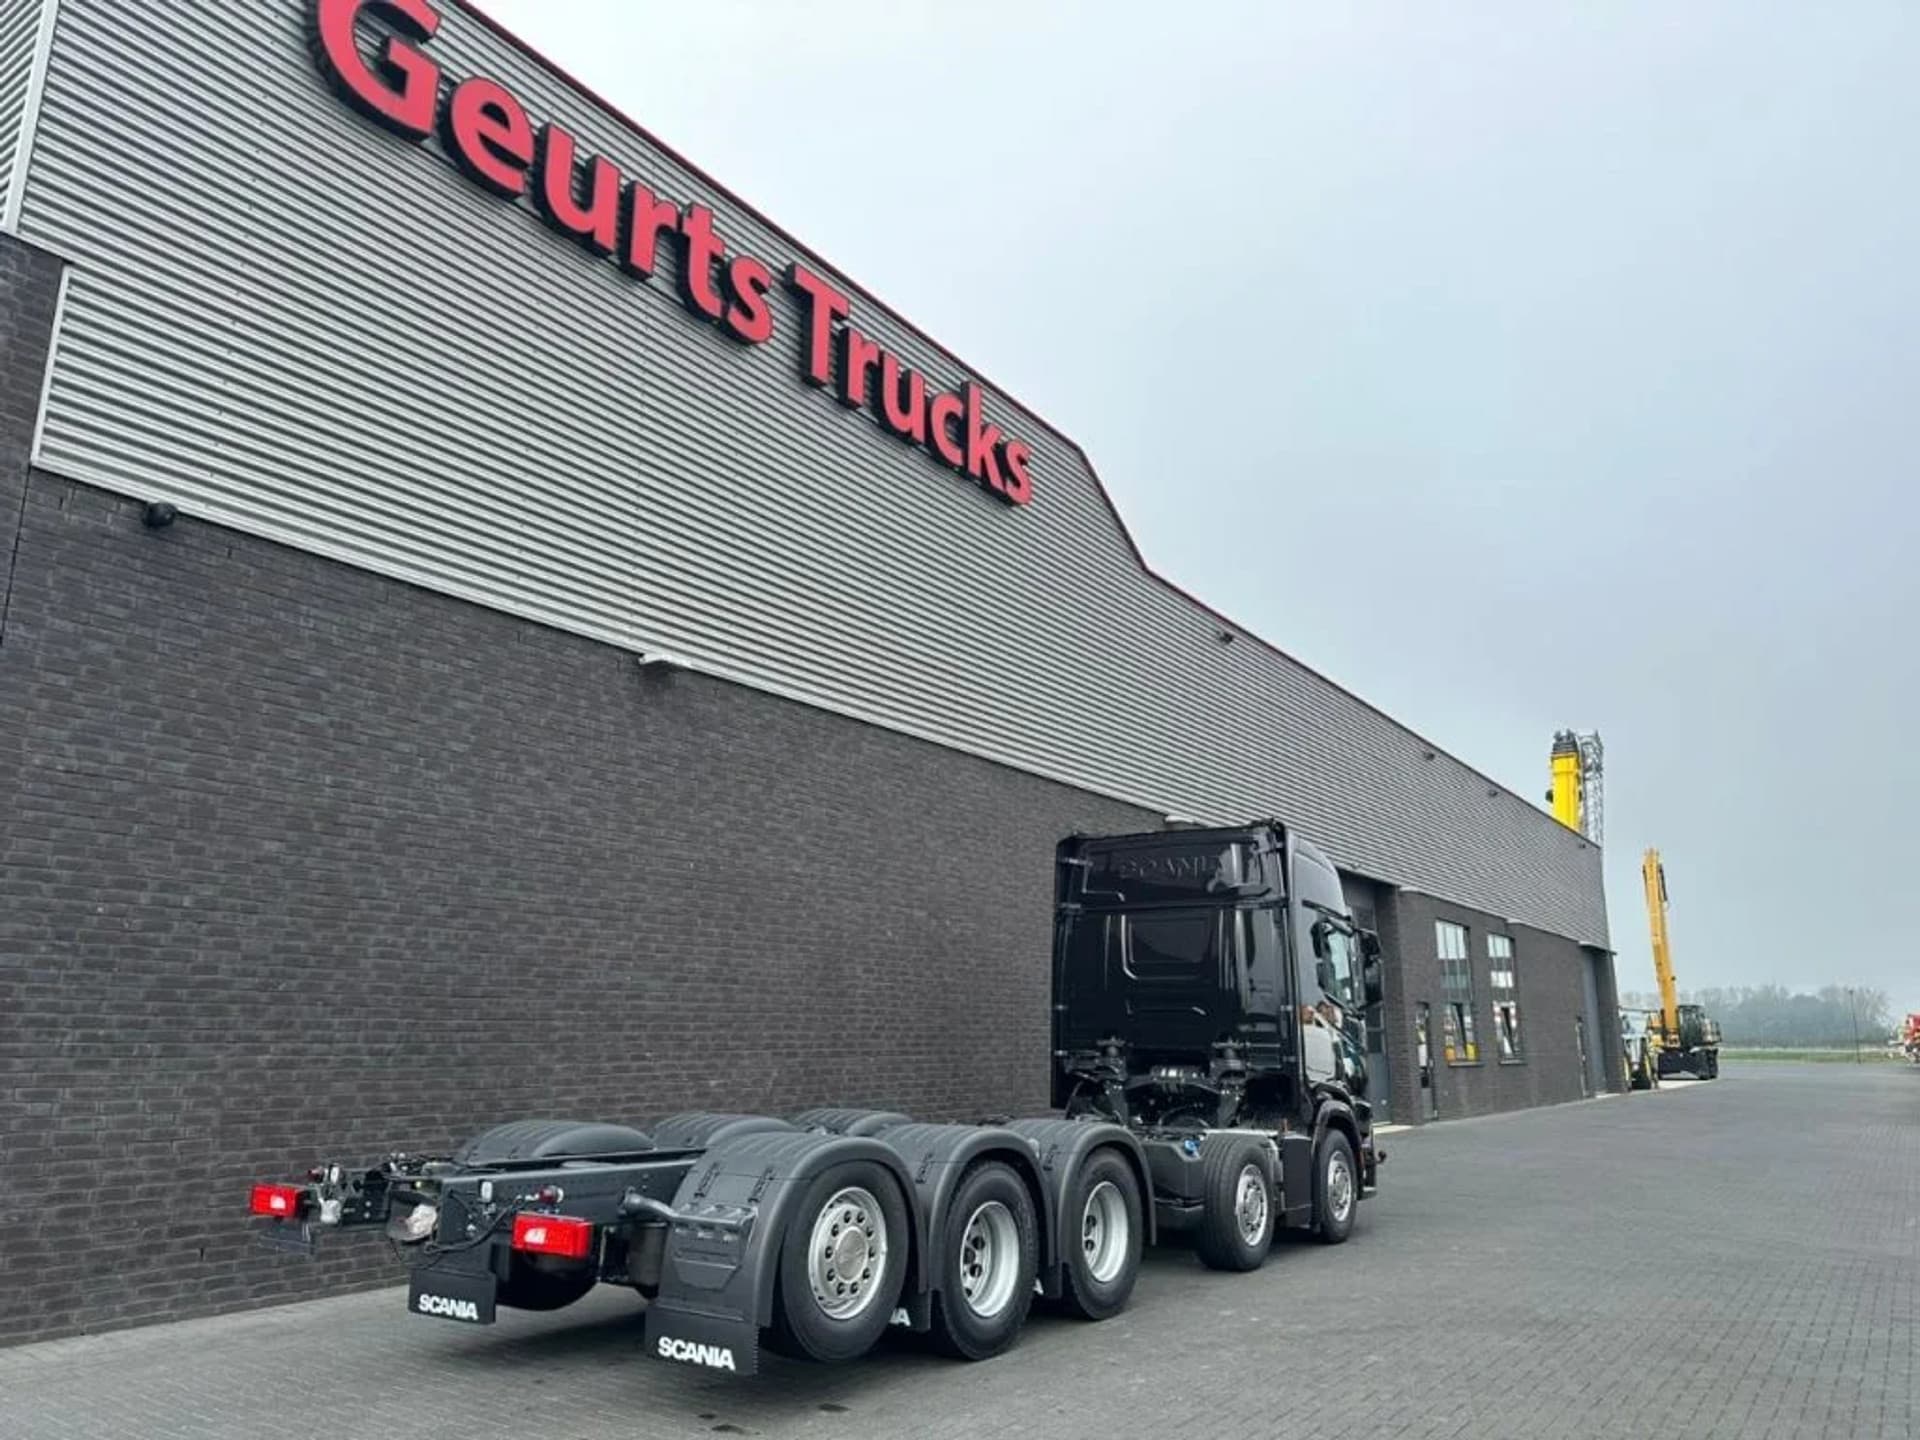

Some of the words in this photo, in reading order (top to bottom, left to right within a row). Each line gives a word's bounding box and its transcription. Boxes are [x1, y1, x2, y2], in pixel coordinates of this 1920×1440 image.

[312, 0, 773, 345] Geurts
[788, 263, 1033, 505] Trucks
[418, 1293, 479, 1321] SCANIA
[657, 1335, 736, 1371] SCANIA
